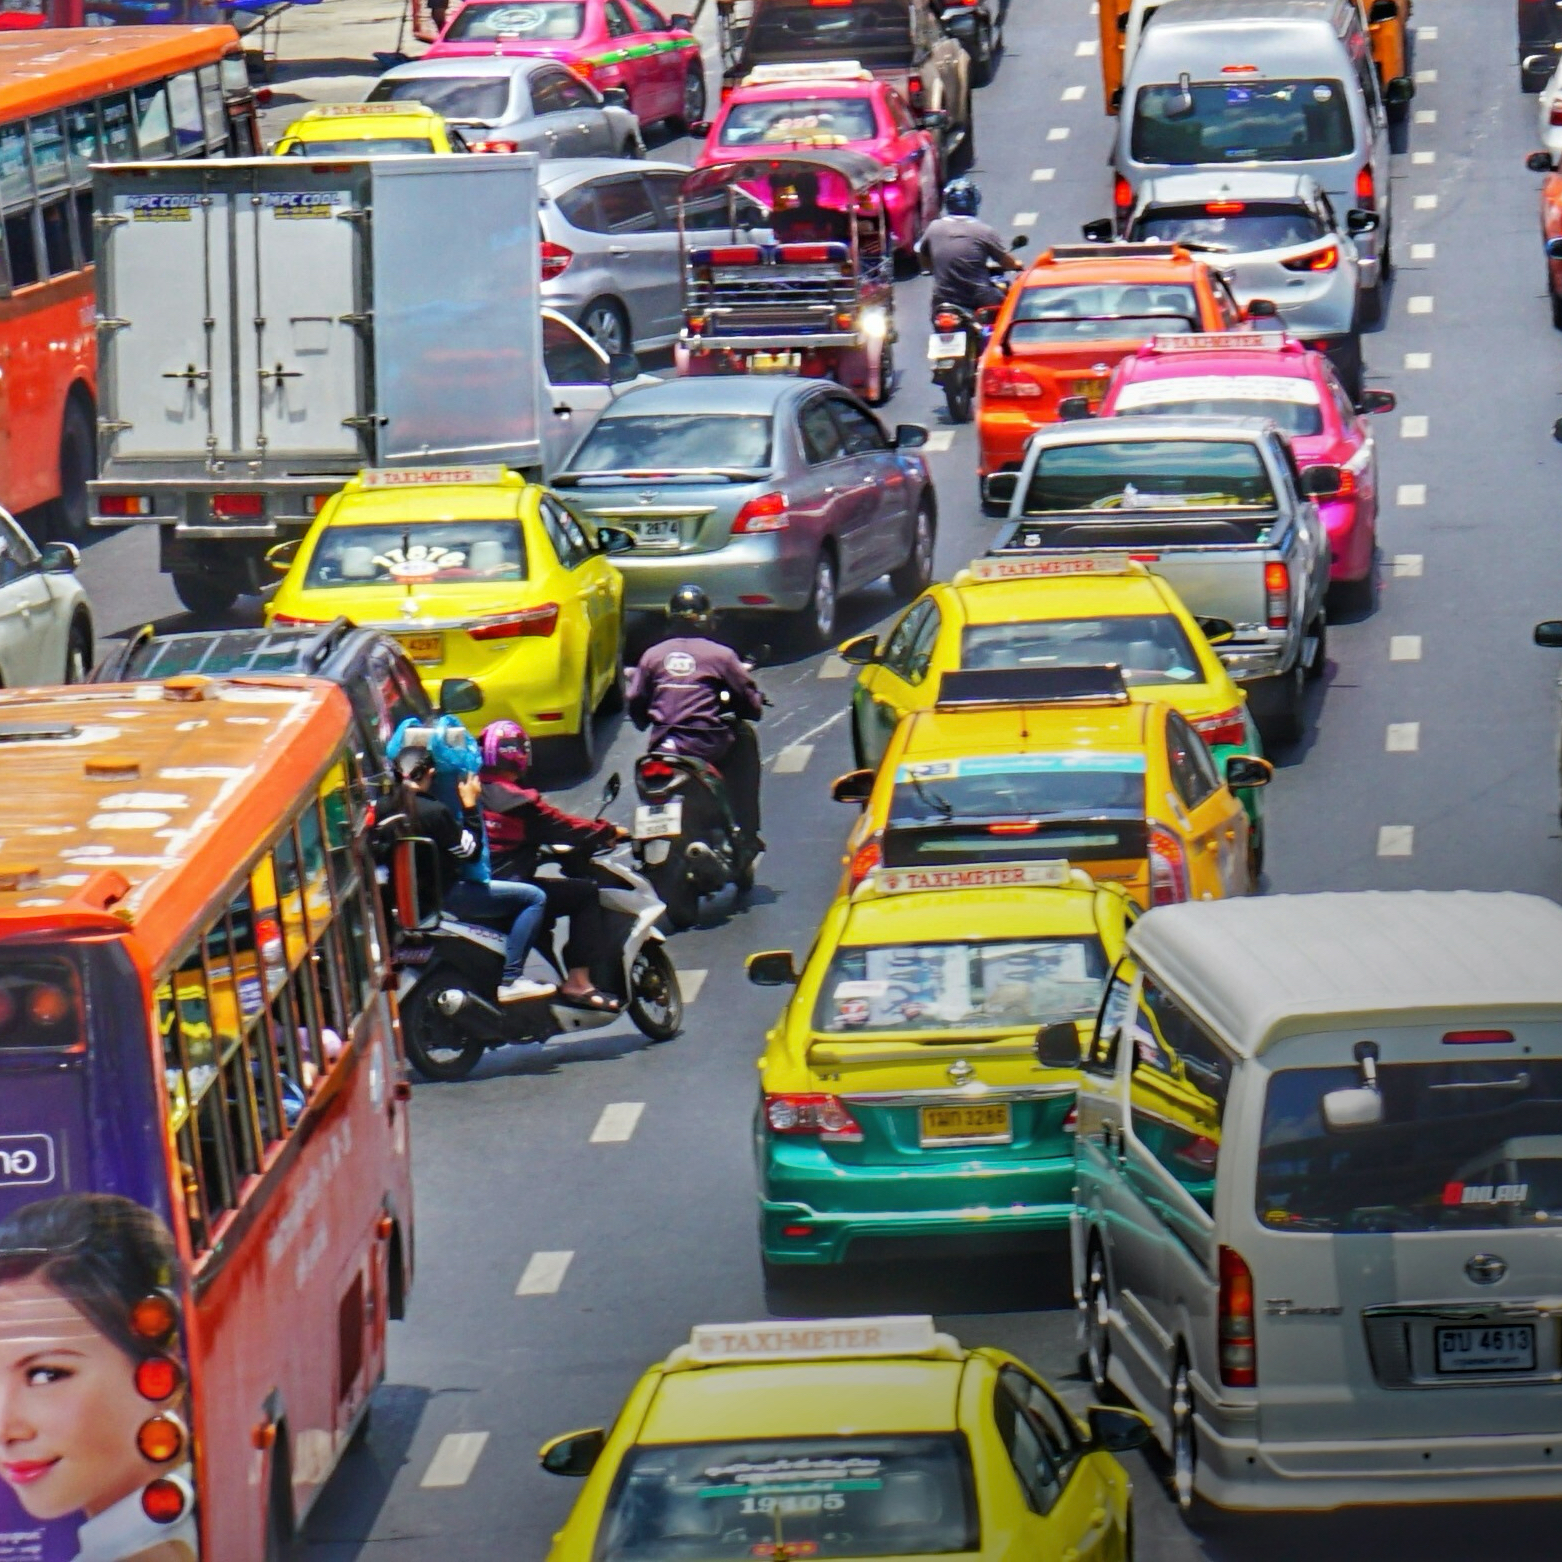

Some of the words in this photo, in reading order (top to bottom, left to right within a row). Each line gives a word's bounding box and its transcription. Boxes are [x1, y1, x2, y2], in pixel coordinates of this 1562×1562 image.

[126, 195, 159, 208] MPC
[160, 194, 201, 208] COOL
[383, 470, 473, 485] TAXI-METER
[998, 560, 1094, 577] TAXI-METER
[908, 869, 1026, 888] TAXI-METER
[722, 1328, 880, 1353] TAXI-METER
